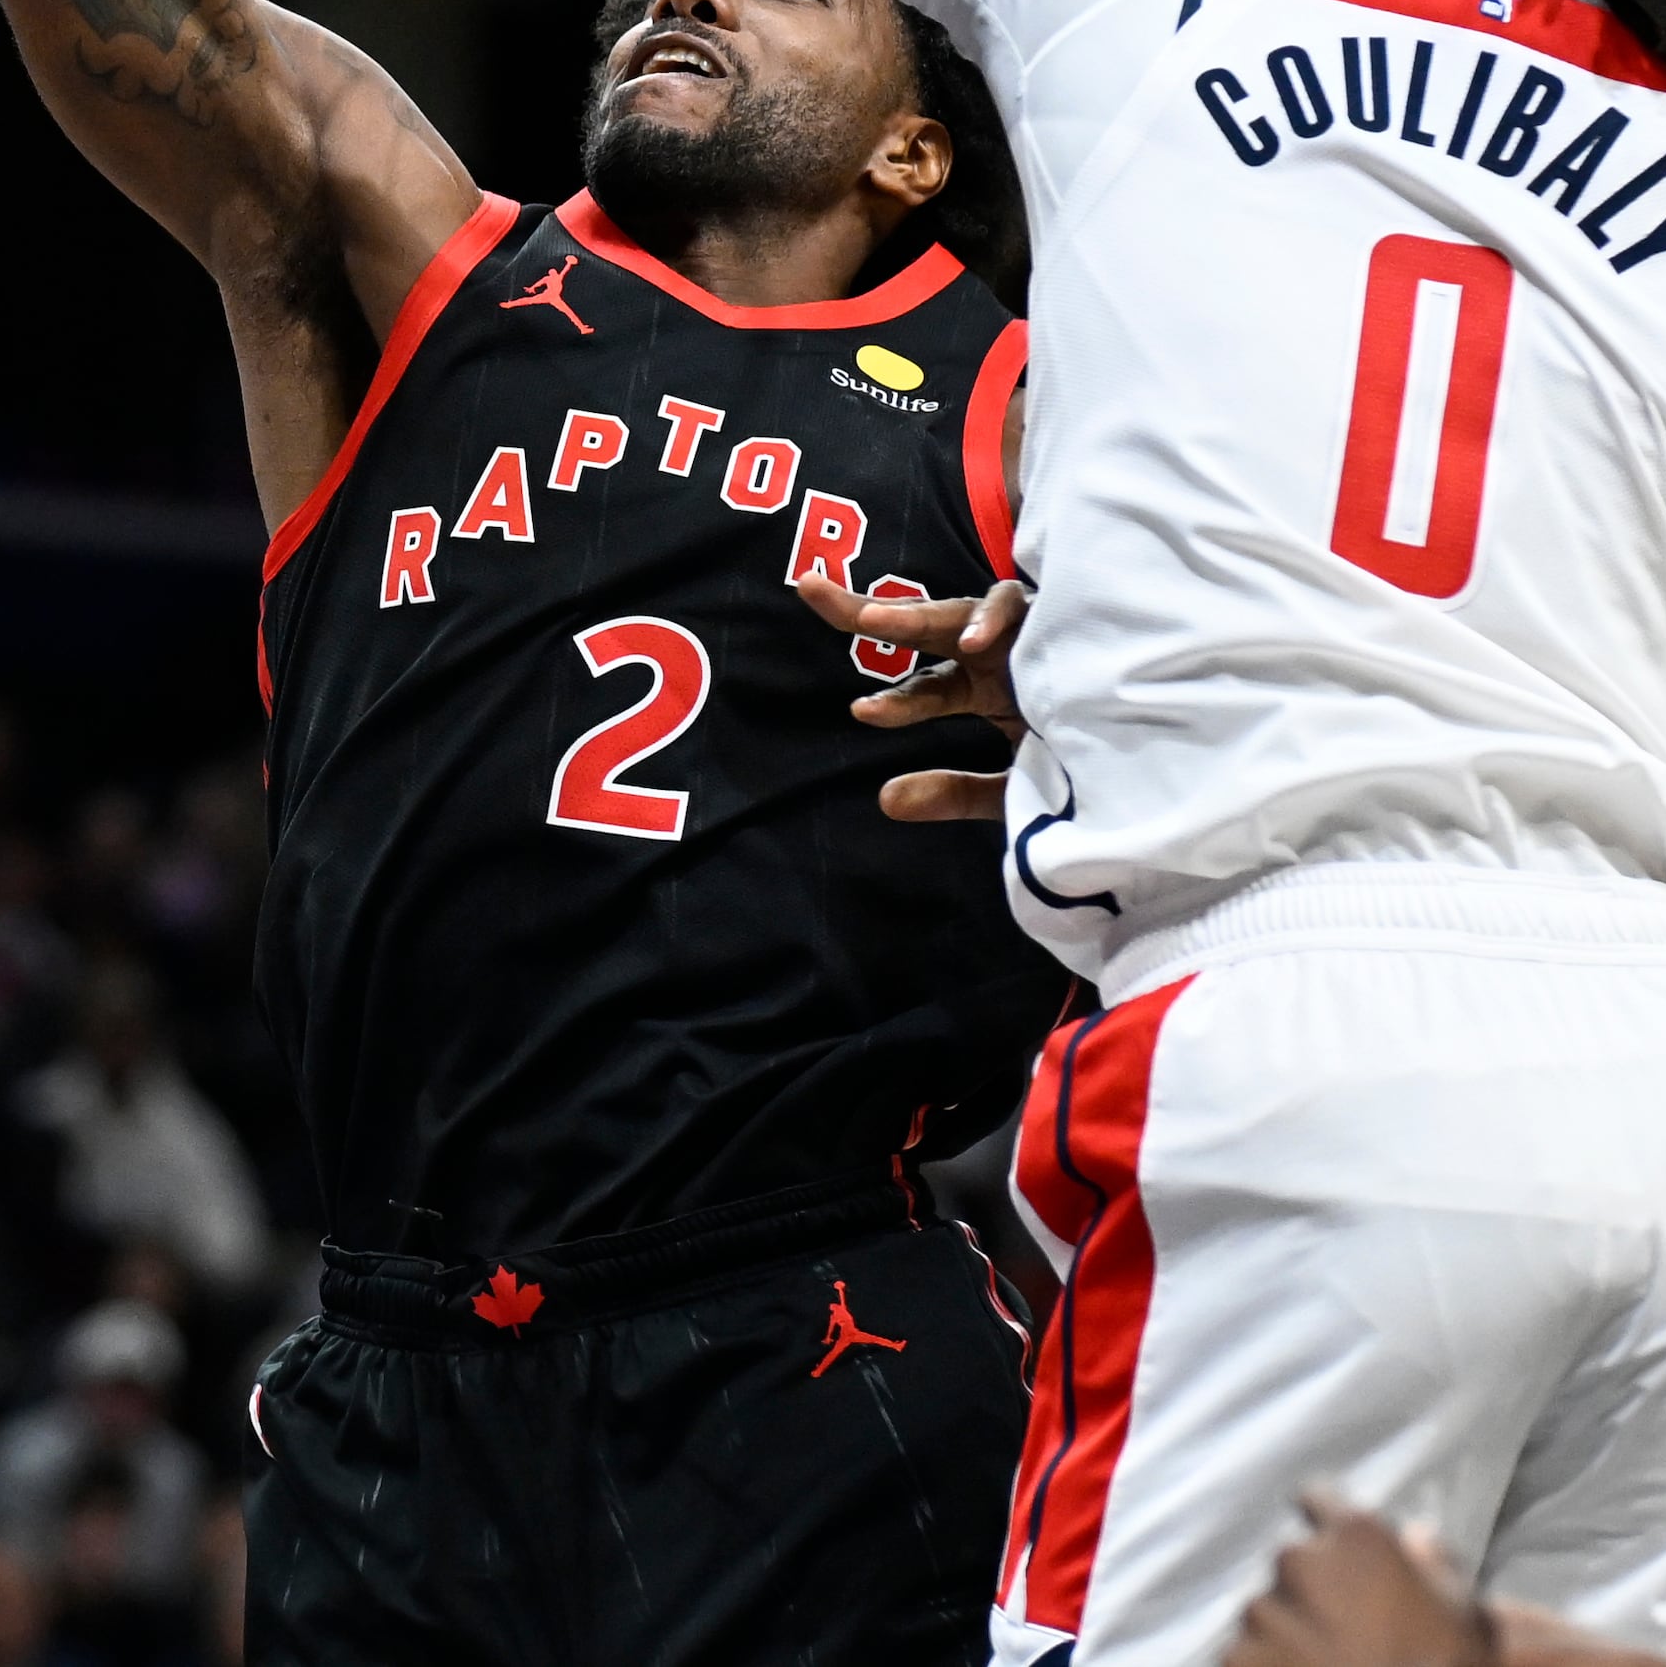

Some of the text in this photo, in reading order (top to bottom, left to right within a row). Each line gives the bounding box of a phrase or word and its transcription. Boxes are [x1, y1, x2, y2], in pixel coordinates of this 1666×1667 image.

[379, 394, 933, 683] RAPTORS
[1329, 232, 1514, 599] 0
[546, 615, 712, 841] 2
